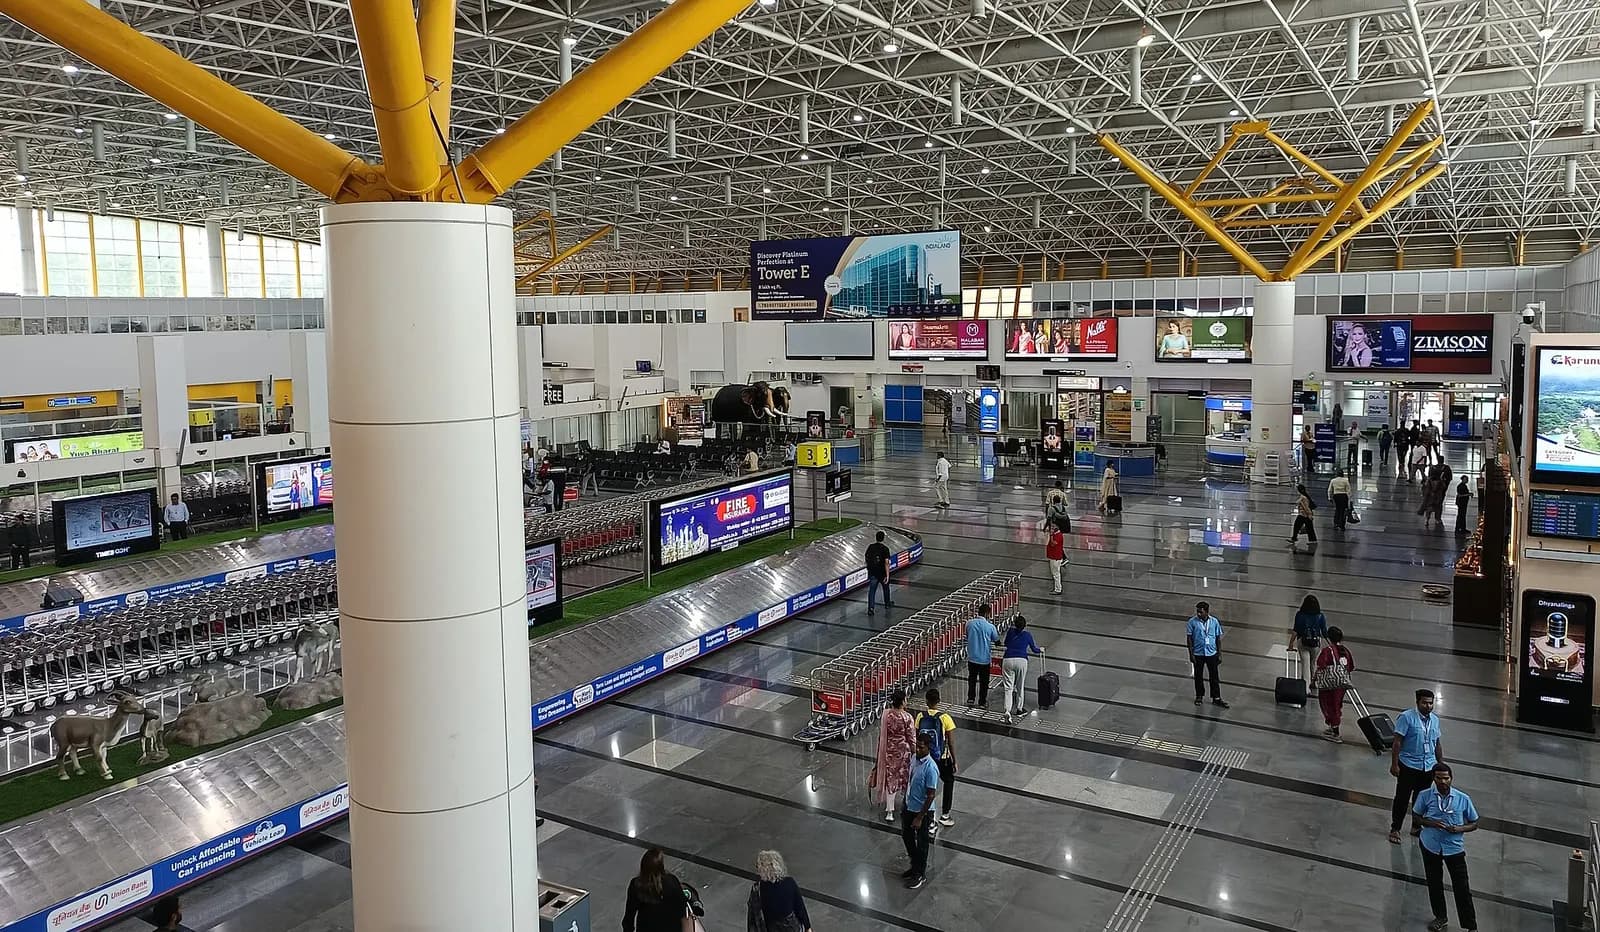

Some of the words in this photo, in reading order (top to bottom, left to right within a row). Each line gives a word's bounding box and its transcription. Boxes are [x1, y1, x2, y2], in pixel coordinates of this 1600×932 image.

[757, 266, 798, 280] Tower
[800, 265, 810, 279] E
[1414, 335, 1488, 349] ZIMSON
[544, 390, 562, 401] FREE
[807, 449, 813, 460] 3
[823, 447, 828, 459] 3
[726, 497, 748, 512] FIRE
[723, 507, 751, 521] INSURANCE
[1538, 600, 1576, 609] Dhyanalinga
[245, 835, 268, 849] Vehicle
[269, 828, 285, 841] Loan
[171, 855, 198, 872] Unlock
[198, 837, 241, 861] Affordable
[178, 866, 194, 879] Car
[195, 849, 236, 872] Financing
[111, 887, 130, 900] Union
[131, 880, 148, 891] Bank
